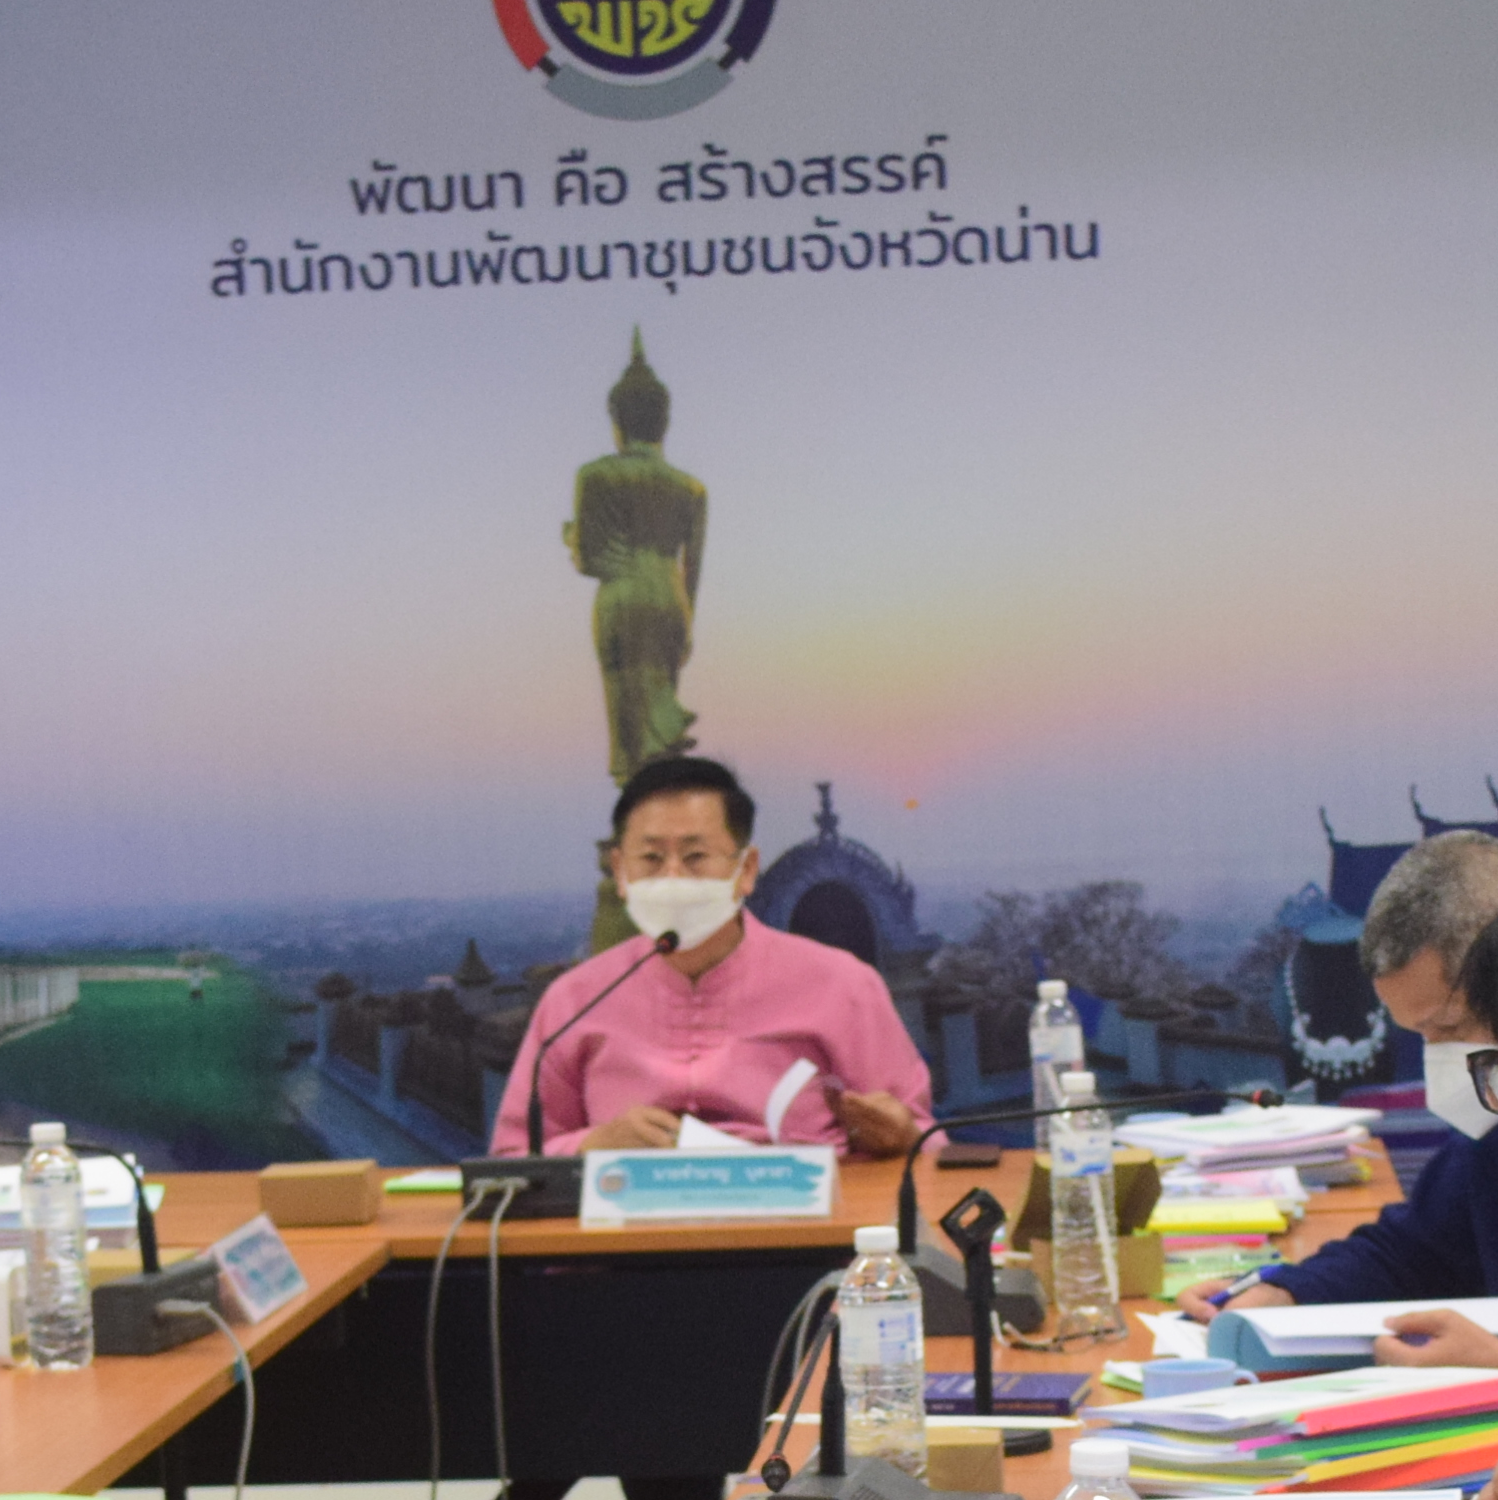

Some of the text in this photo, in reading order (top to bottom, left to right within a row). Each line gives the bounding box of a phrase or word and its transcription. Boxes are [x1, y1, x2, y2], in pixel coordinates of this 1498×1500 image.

[348, 133, 949, 216] พัฒนา คือ สร้างสรรค์
[210, 213, 1100, 298] สำนักงานพัฒนาชุมชนจังหวัดน่าน
